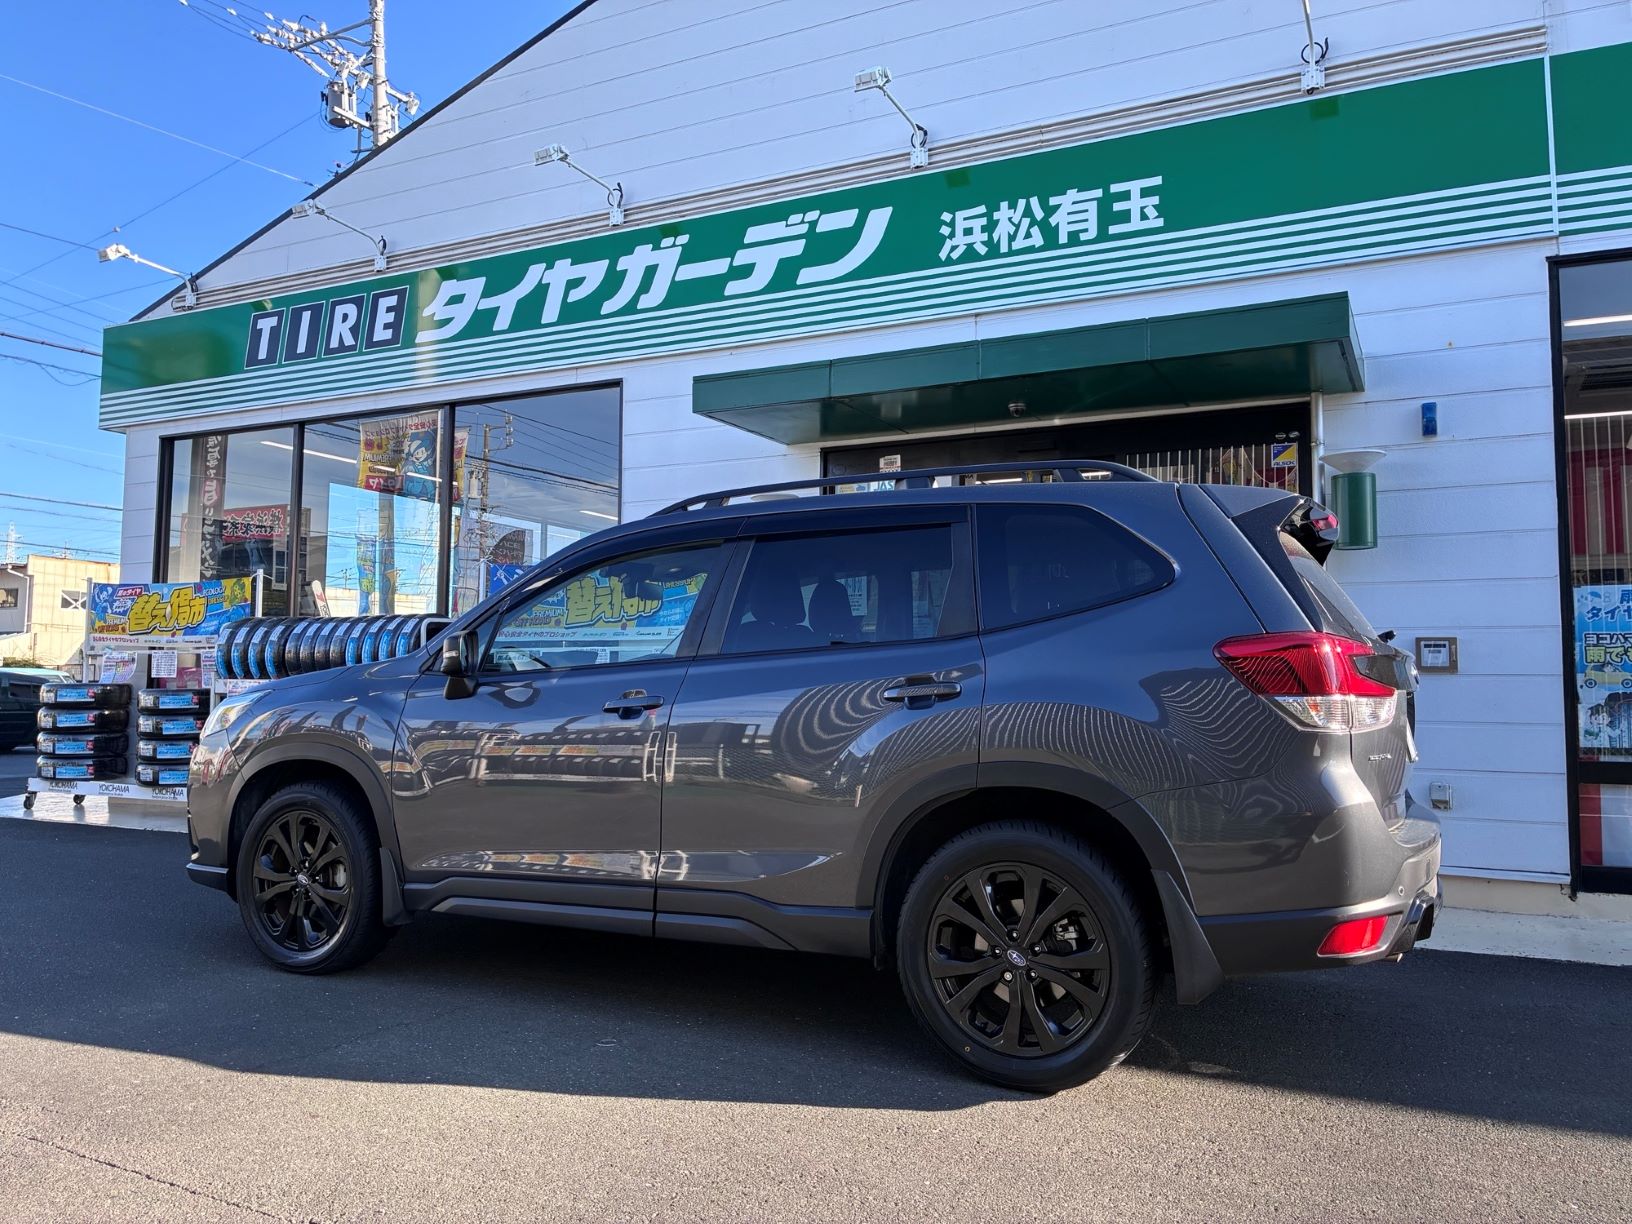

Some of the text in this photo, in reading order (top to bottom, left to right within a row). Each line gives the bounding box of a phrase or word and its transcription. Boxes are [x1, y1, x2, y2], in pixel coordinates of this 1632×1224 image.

[256, 175, 1164, 360] TIRE タイヤガーデン 浜松有玉
[50, 780, 78, 790] YOKOHAMA
[99, 783, 130, 793] YOKOHAMA
[151, 787, 185, 797] YOKOHAMA
